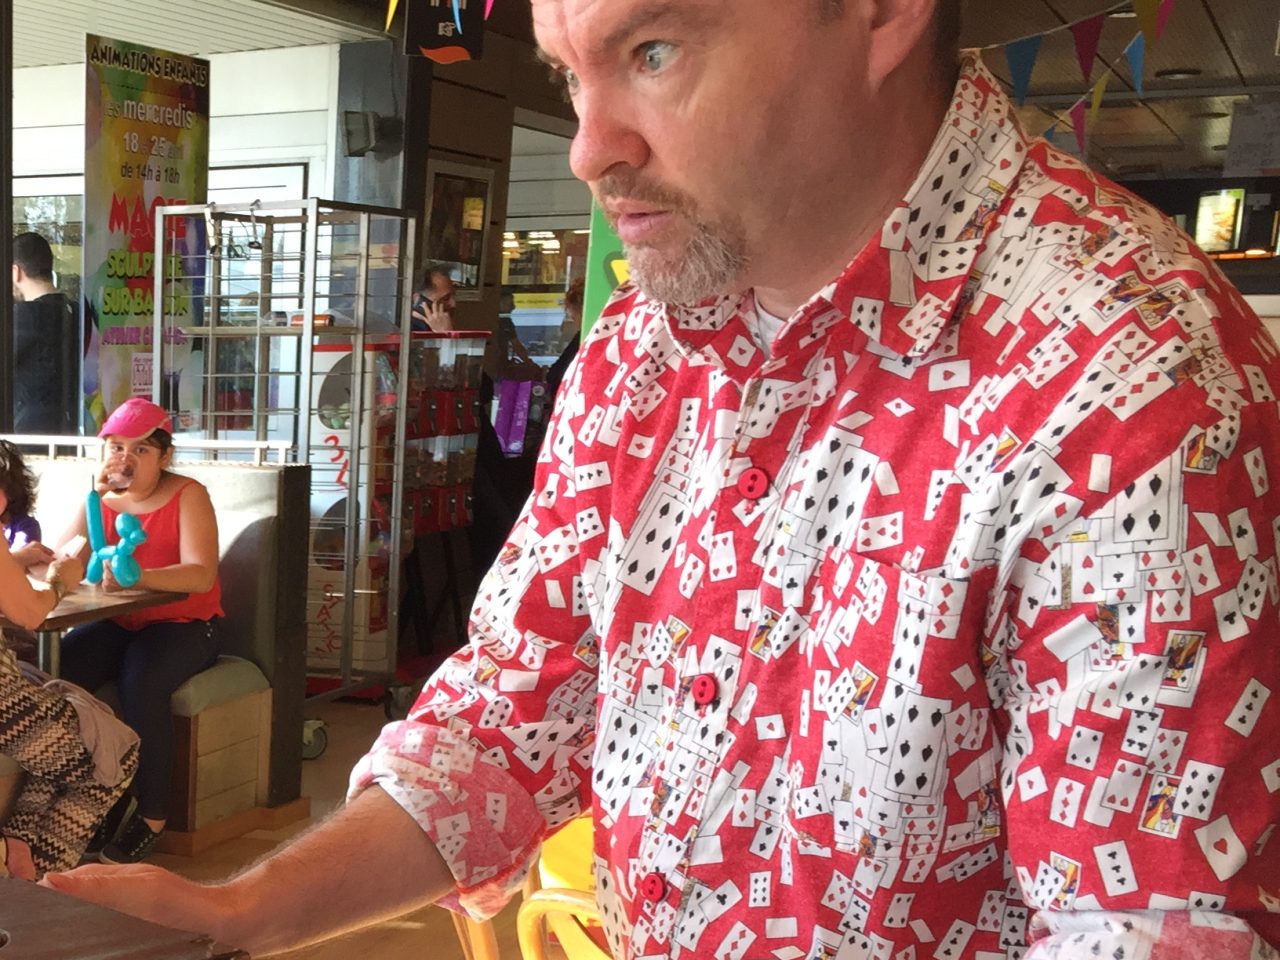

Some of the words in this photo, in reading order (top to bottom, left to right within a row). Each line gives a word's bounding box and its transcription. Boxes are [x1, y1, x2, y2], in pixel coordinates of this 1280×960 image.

[90, 45, 161, 77] ANIMATIONS
[163, 60, 208, 87] ENFANTS
[123, 99, 193, 129] mercredis
[123, 132, 139, 154] 18
[120, 162, 133, 179] de
[136, 164, 153, 181] 14h
[156, 167, 161, 182] à
[164, 167, 180, 184] 18h
[107, 249, 183, 281] SCULPRE
[103, 287, 129, 316] SUR
[134, 287, 189, 317] BAON
